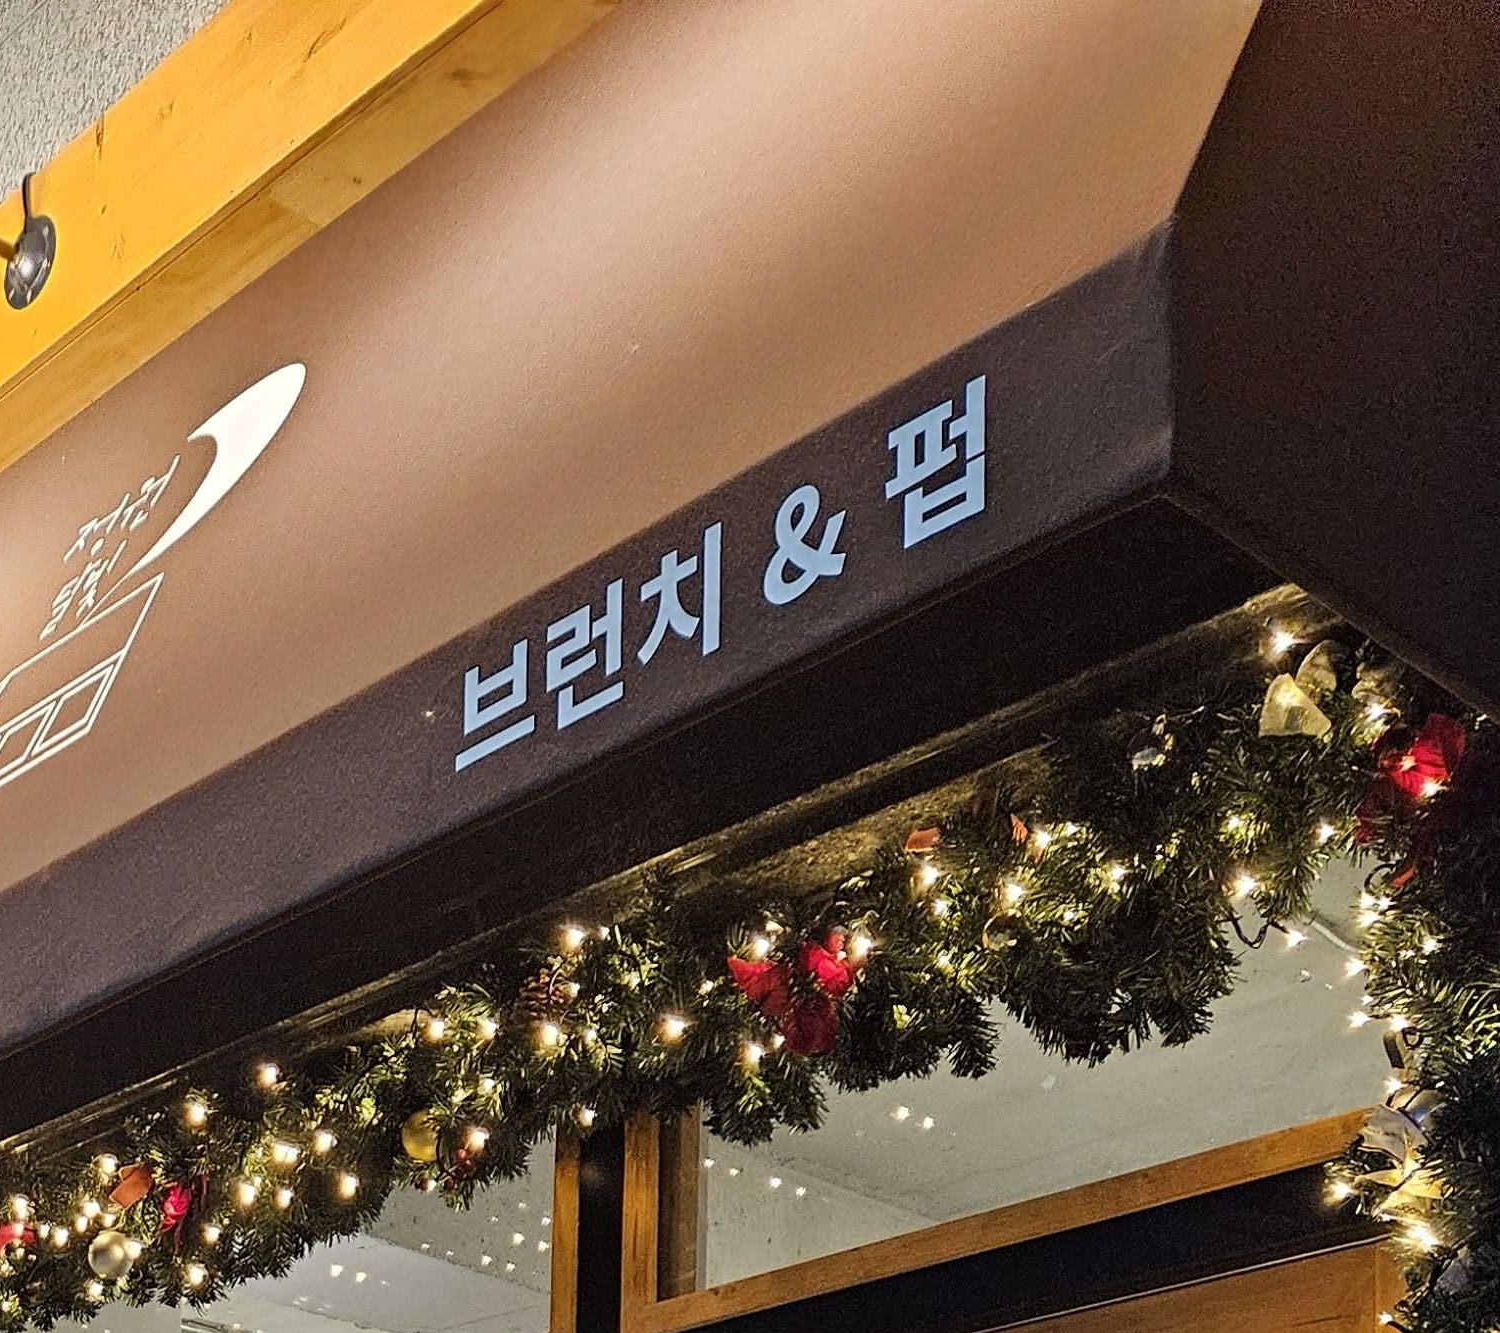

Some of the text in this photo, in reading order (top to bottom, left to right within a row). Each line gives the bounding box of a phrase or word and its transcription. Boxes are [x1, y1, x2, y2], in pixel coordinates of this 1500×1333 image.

[455, 374, 986, 773] 브런치 & 펍
